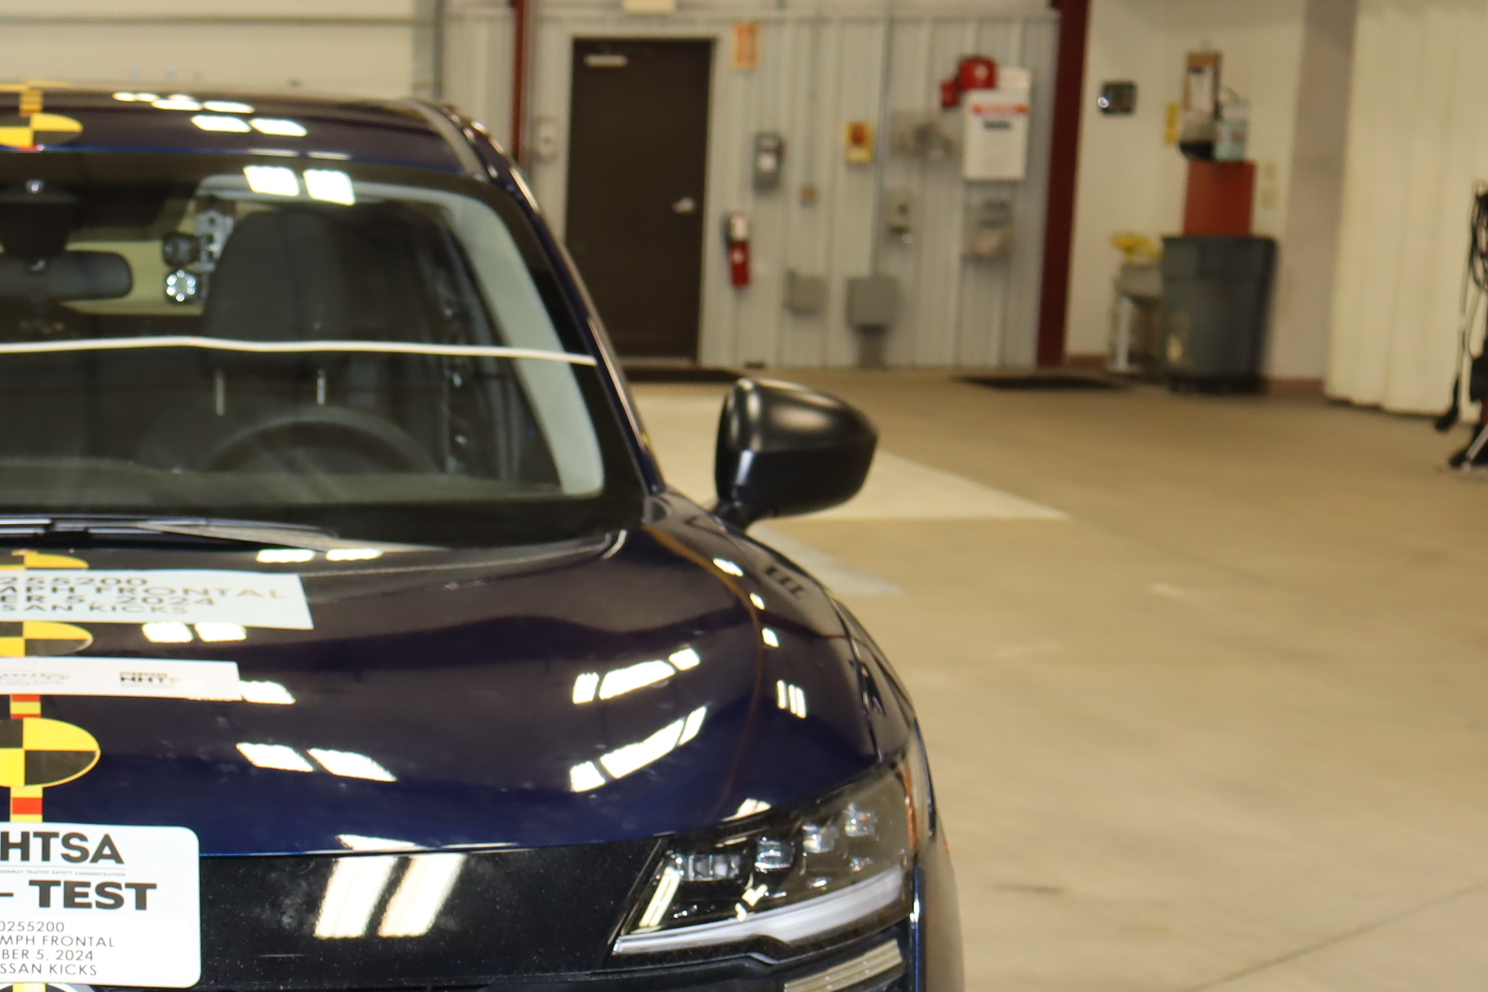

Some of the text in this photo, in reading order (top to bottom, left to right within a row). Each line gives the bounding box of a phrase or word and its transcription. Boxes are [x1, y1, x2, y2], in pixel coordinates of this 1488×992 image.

[95, 586, 287, 598] FRONTAL
[116, 595, 216, 606] 2024
[88, 604, 188, 614] KICKS
[28, 879, 158, 911] TEST
[0, 935, 37, 947] MPH
[42, 935, 116, 948] FRONTAL
[35, 949, 50, 962] 5,
[56, 950, 94, 962] 2024
[49, 964, 98, 976] KICKS
